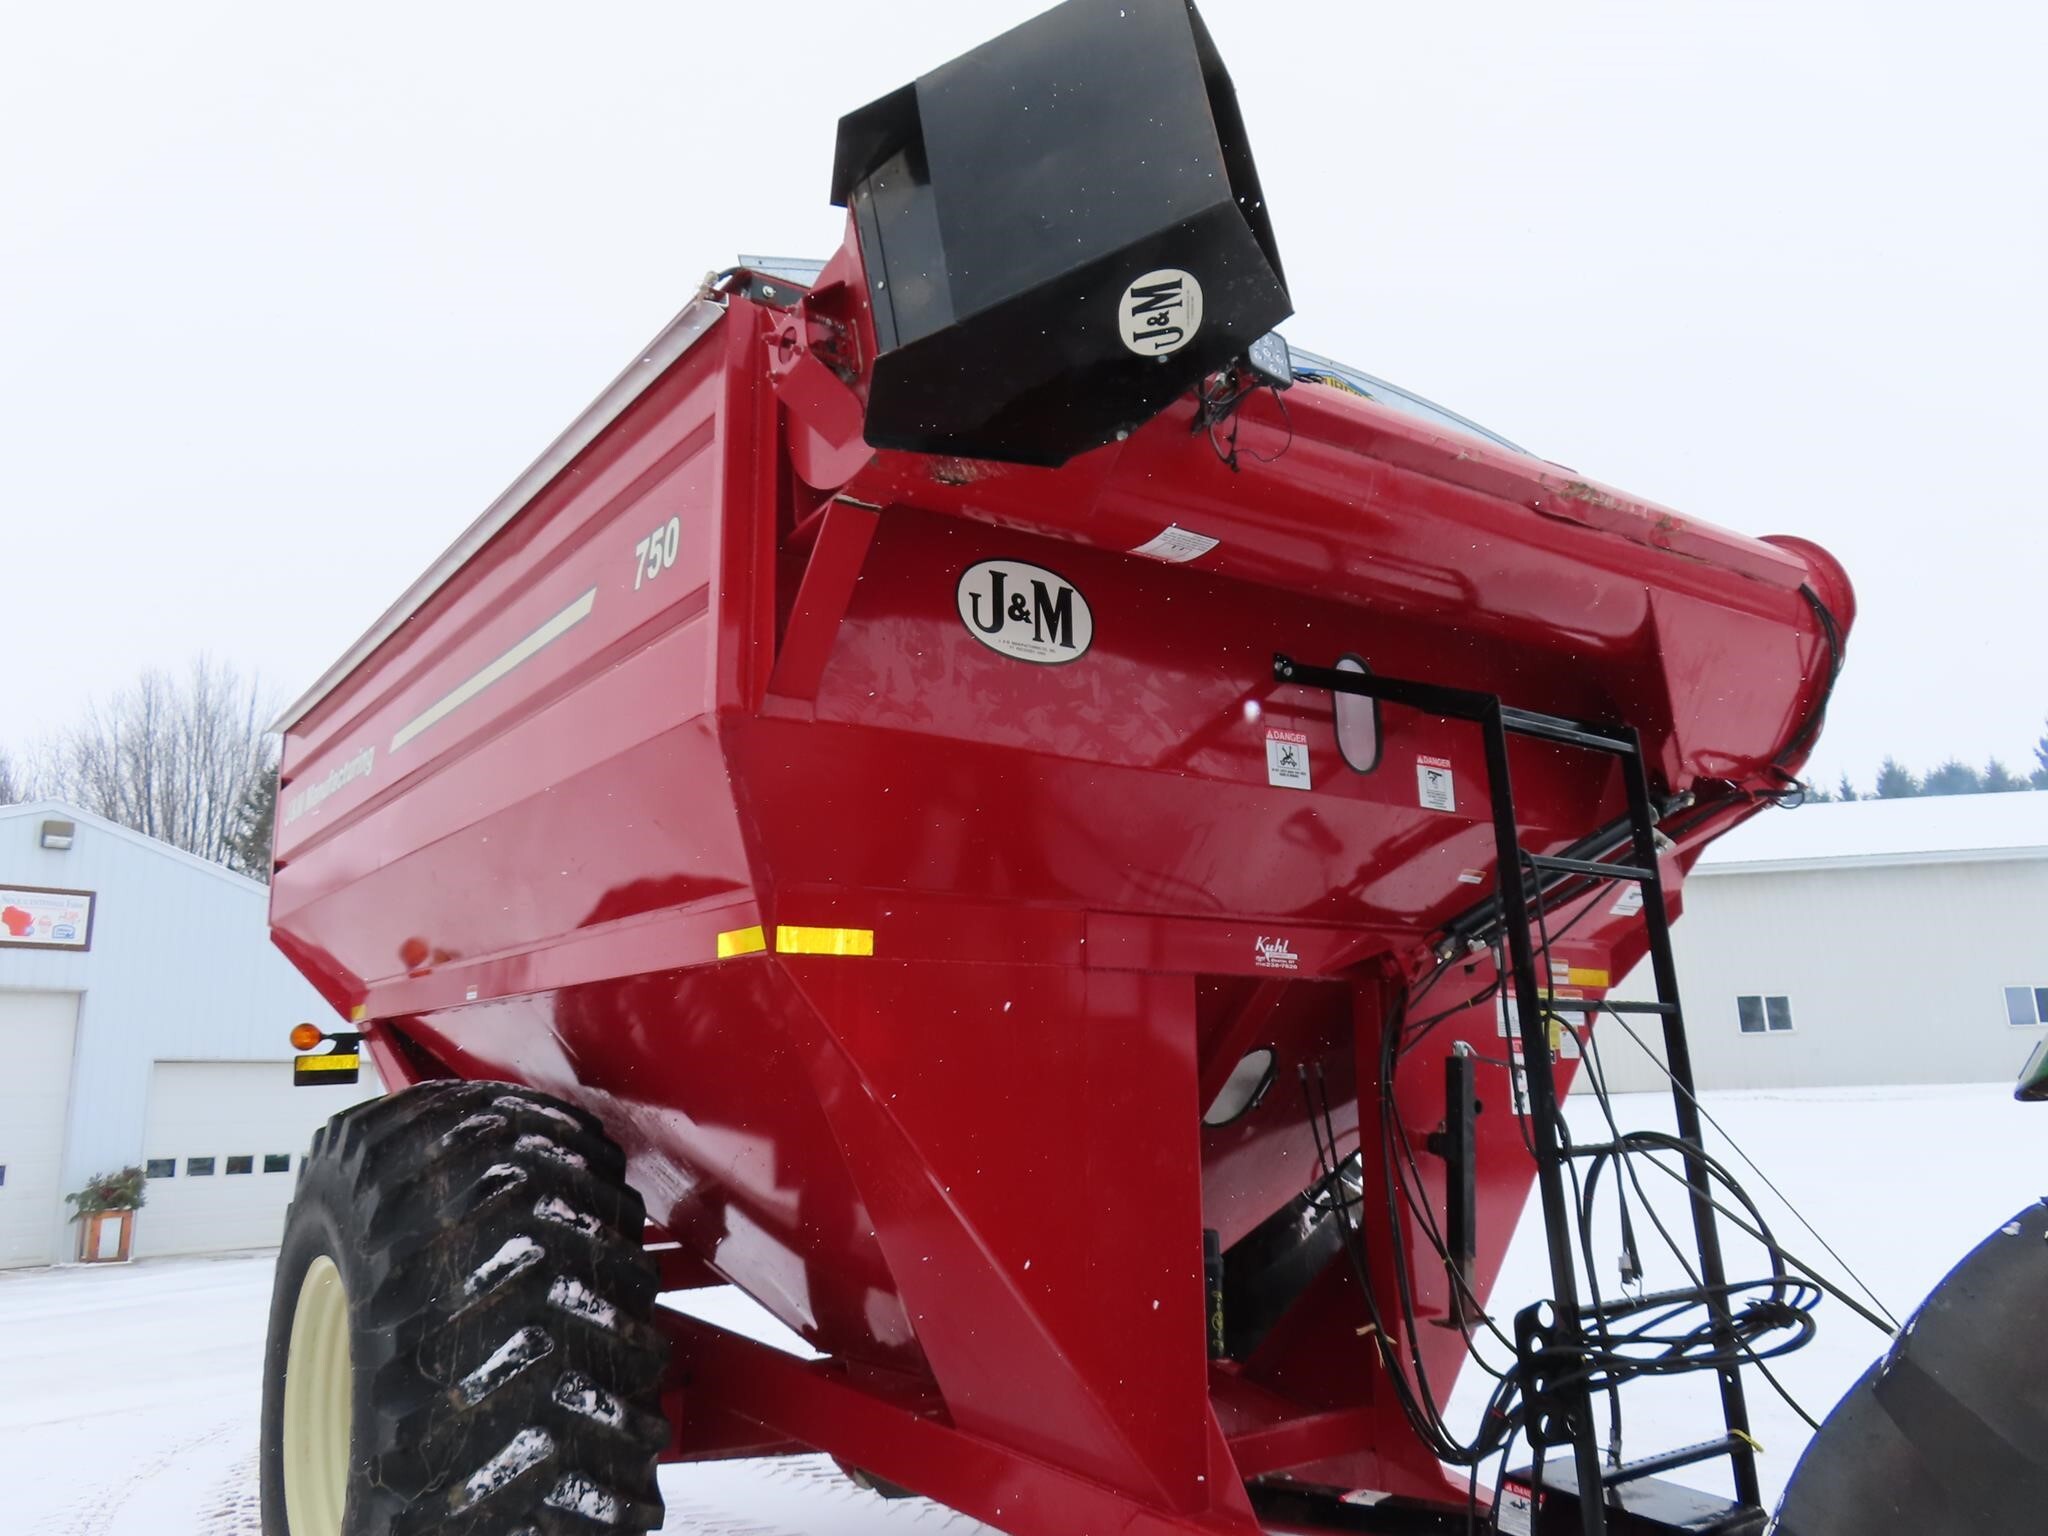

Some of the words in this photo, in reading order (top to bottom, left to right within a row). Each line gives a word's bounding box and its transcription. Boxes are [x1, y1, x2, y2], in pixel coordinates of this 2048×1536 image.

[1130, 278, 1184, 350] J&M
[634, 516, 680, 590] 750
[969, 569, 1076, 649] J&M
[1273, 730, 1307, 744] DANGER
[1423, 756, 1451, 769] DANGER
[1255, 936, 1289, 953] Kuhl
